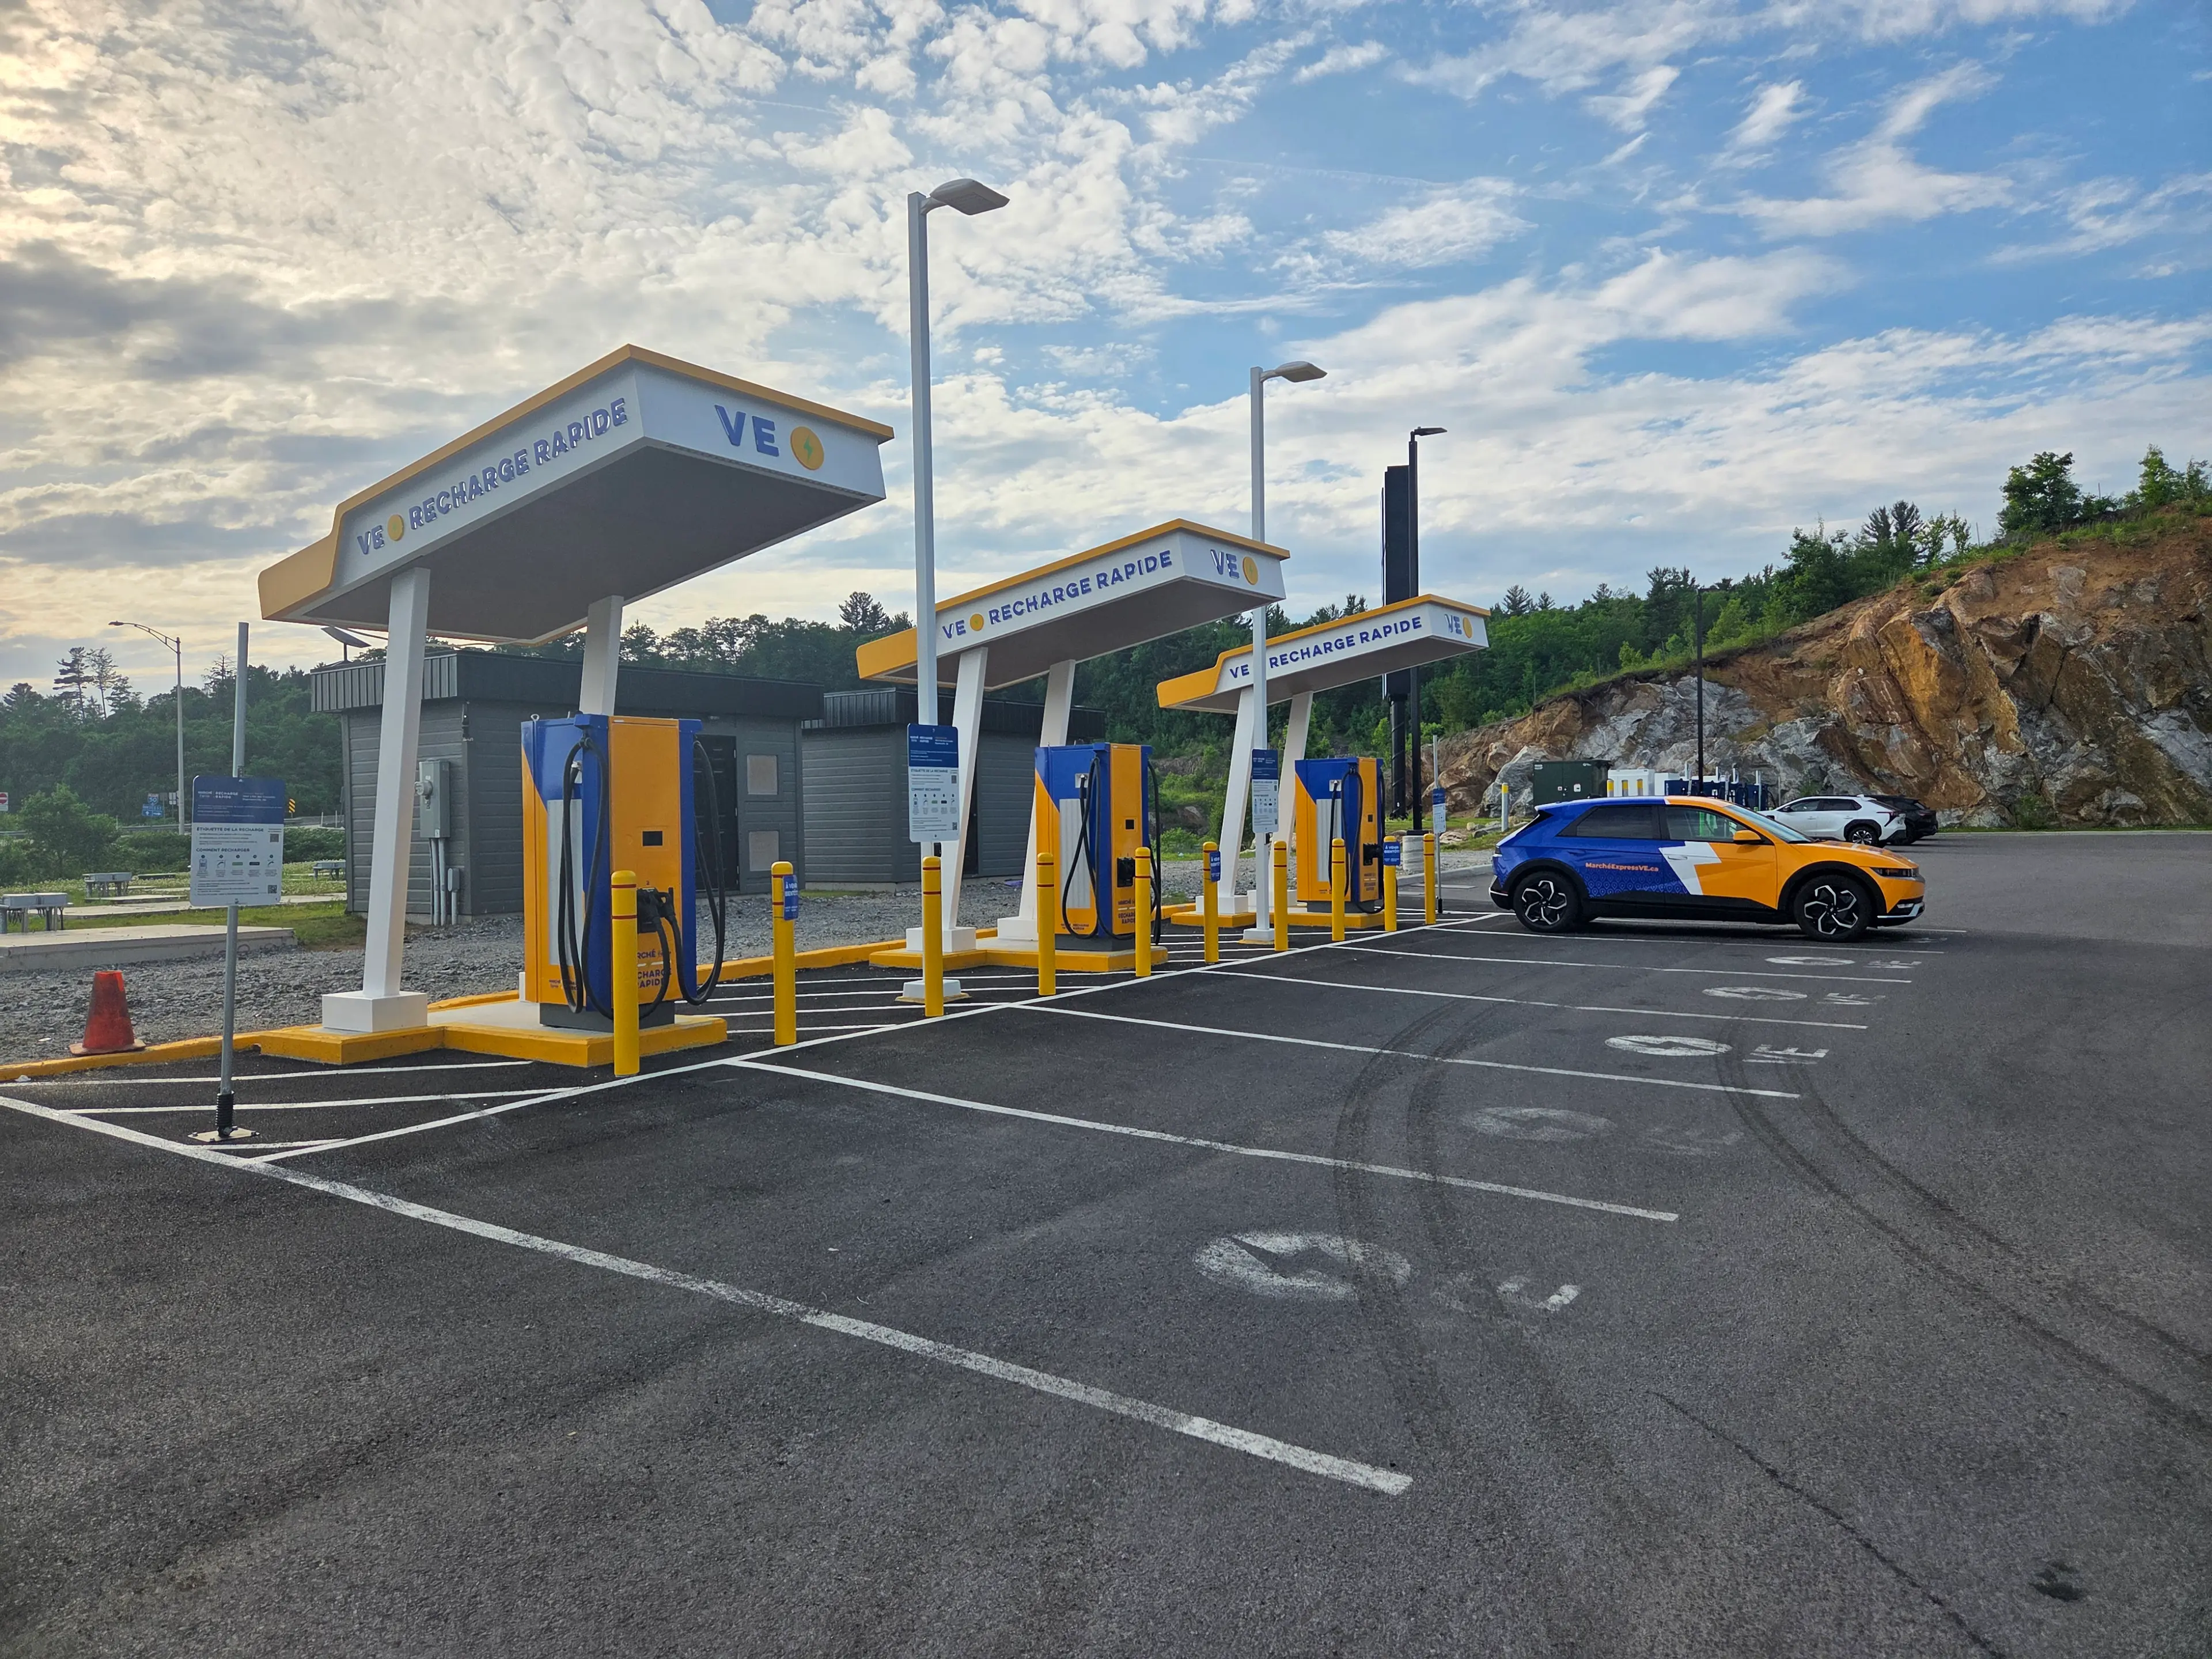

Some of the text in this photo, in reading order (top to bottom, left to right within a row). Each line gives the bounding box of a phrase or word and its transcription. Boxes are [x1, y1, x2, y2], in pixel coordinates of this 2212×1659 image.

[714, 404, 779, 457] VE
[357, 397, 627, 555] VE RECHARGE RAPIDE
[1210, 549, 1240, 579] VE
[942, 550, 1173, 639] VE RECHARGE RAPIDE
[1445, 614, 1462, 635] VE
[1229, 616, 1422, 679] VE RECHARGE RAPIDE
[1585, 862, 1659, 872] MarchéExpressVE.ca
[637, 949, 656, 959] RCHÉ
[637, 979, 662, 989] APID
